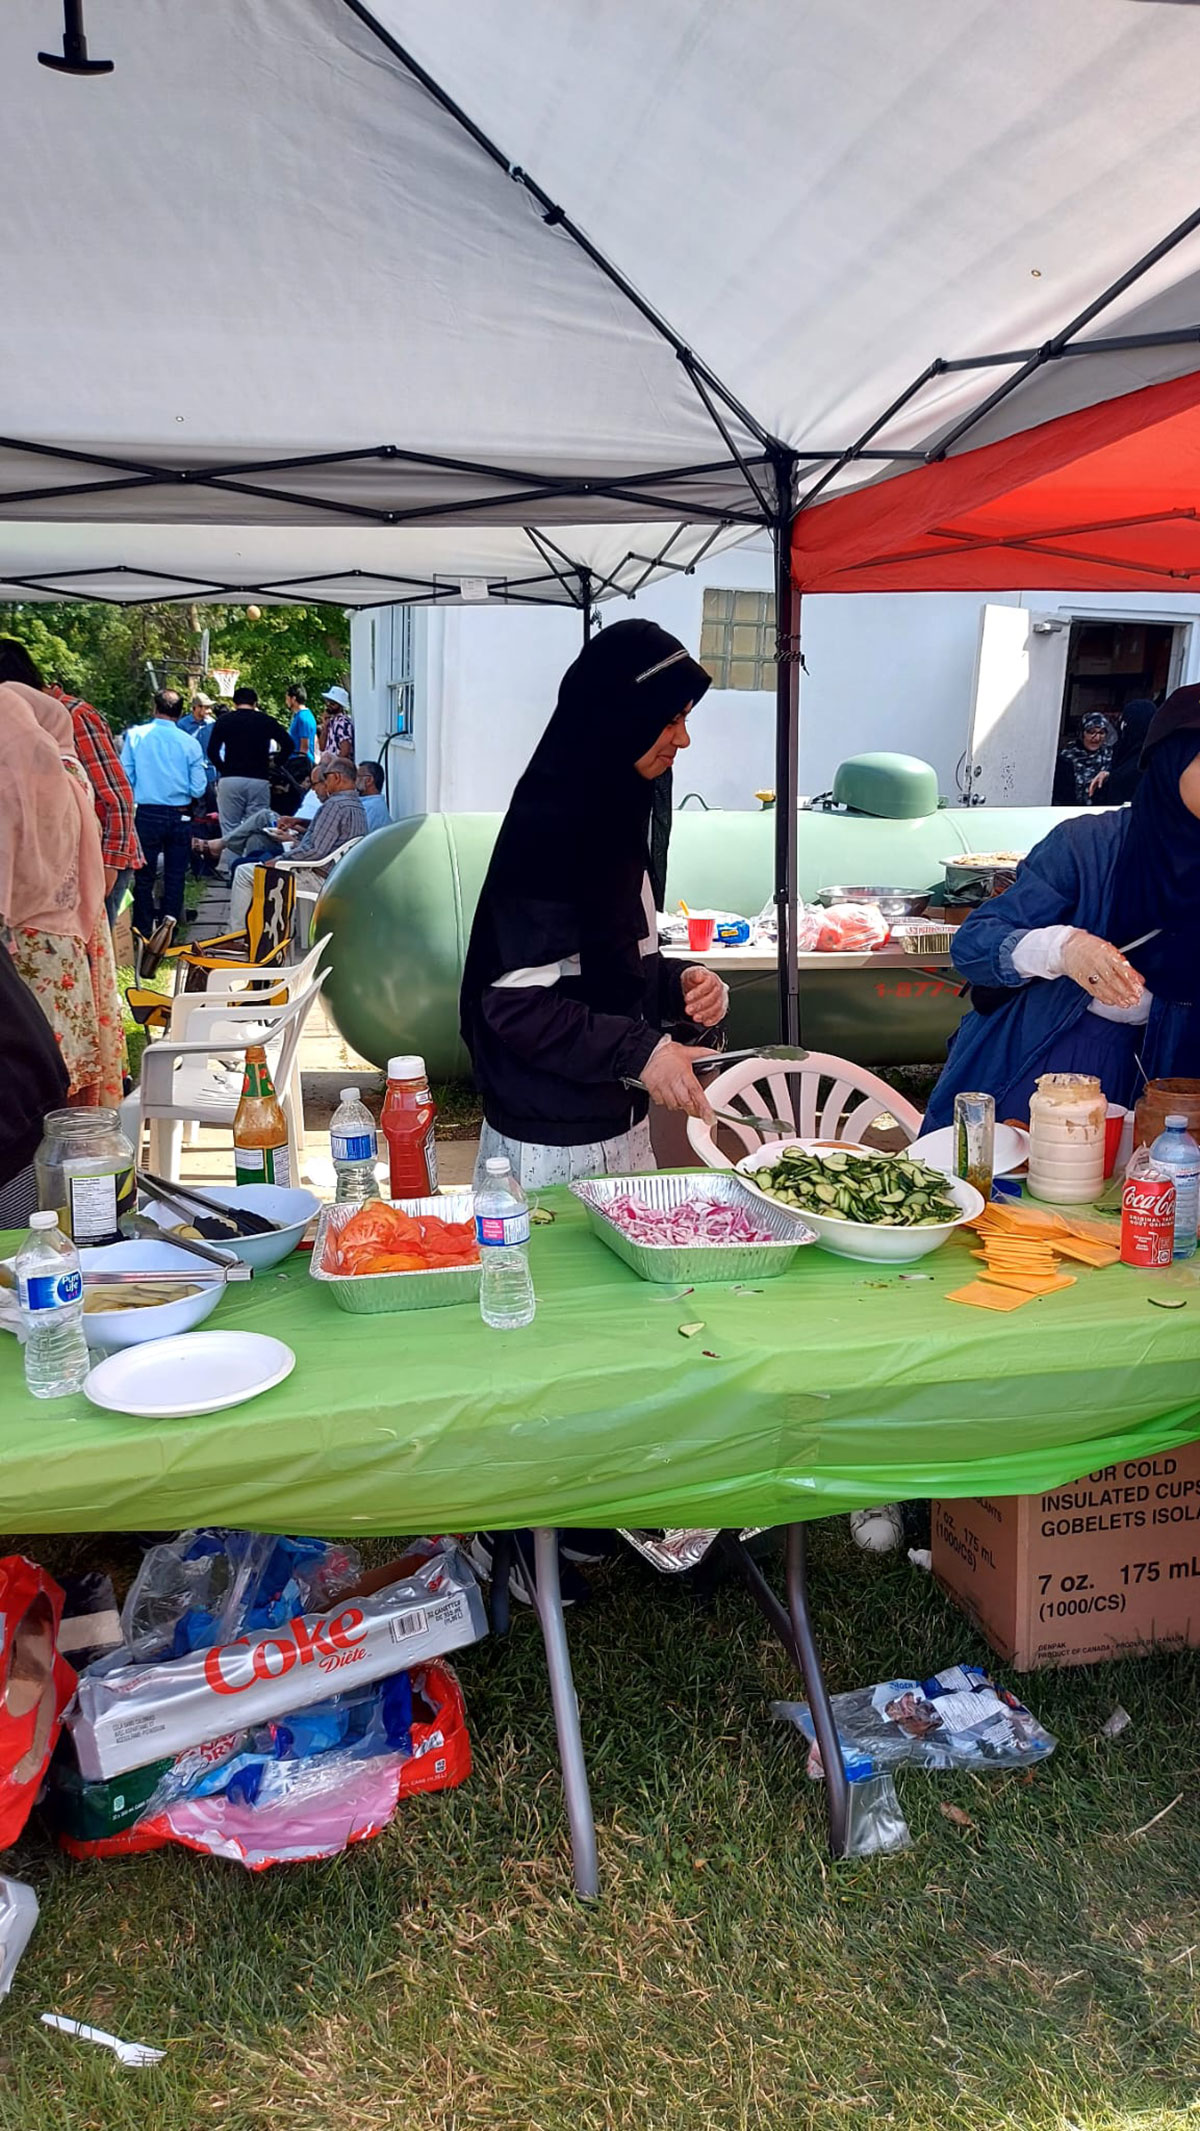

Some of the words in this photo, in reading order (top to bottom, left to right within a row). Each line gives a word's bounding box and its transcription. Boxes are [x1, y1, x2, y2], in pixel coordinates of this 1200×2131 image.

[874, 979, 967, 998] 1-877-
[1089, 1465, 1117, 1483] OR
[1124, 1459, 1177, 1479] COLD
[1041, 1486, 1149, 1512] INSULATED
[1041, 1511, 1146, 1537] GOBELETS
[936, 1520, 977, 1573] (1000/CS)
[964, 1527, 980, 1553] 175
[981, 1545, 997, 1570] mL
[1038, 1574, 1052, 1595] 7
[1060, 1574, 1095, 1592] oz.
[1120, 1561, 1160, 1585] 175
[1169, 1556, 1200, 1579] mL
[1039, 1593, 1126, 1622] (1000/CS)
[204, 1608, 369, 1694] Coke
[318, 1648, 368, 1674] Diète
[1038, 1649, 1070, 1658] PRODUCT
[1083, 1644, 1111, 1654] CANADA
